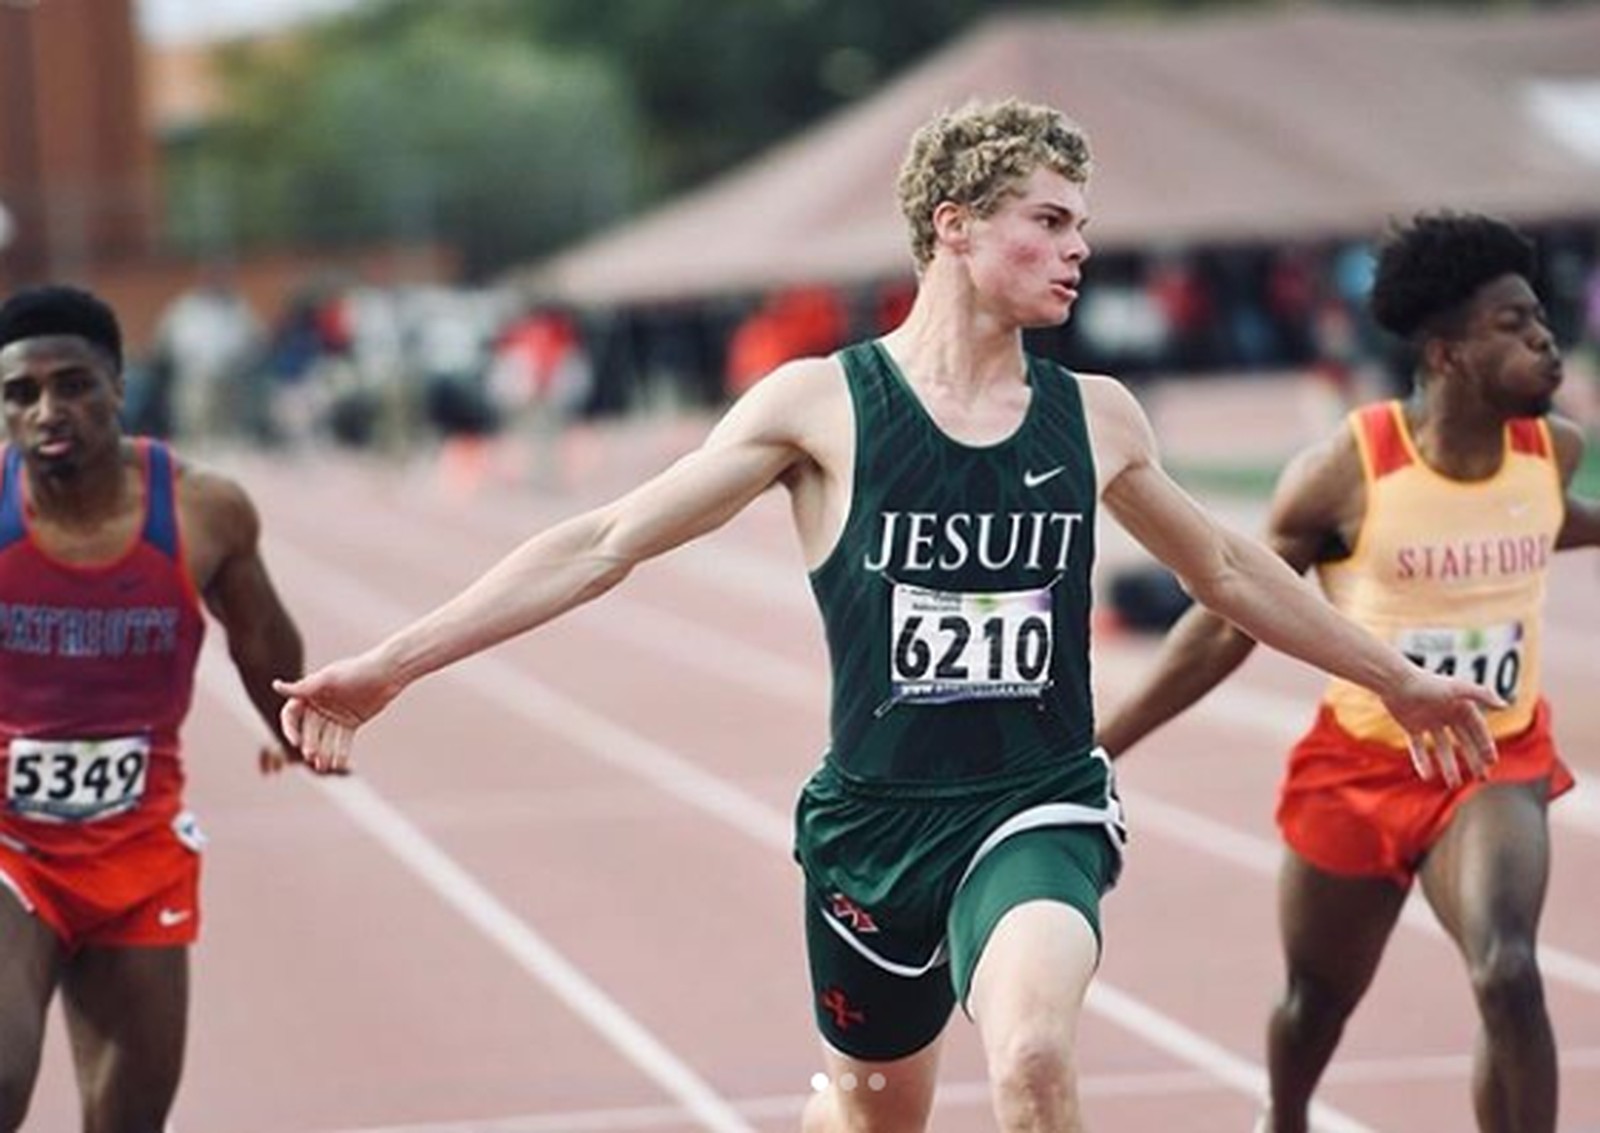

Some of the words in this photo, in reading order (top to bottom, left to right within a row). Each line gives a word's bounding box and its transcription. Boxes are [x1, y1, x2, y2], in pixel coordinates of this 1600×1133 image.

[864, 511, 1083, 571] JESUIT
[895, 615, 1049, 681] 6210
[14, 751, 144, 800] 5349
